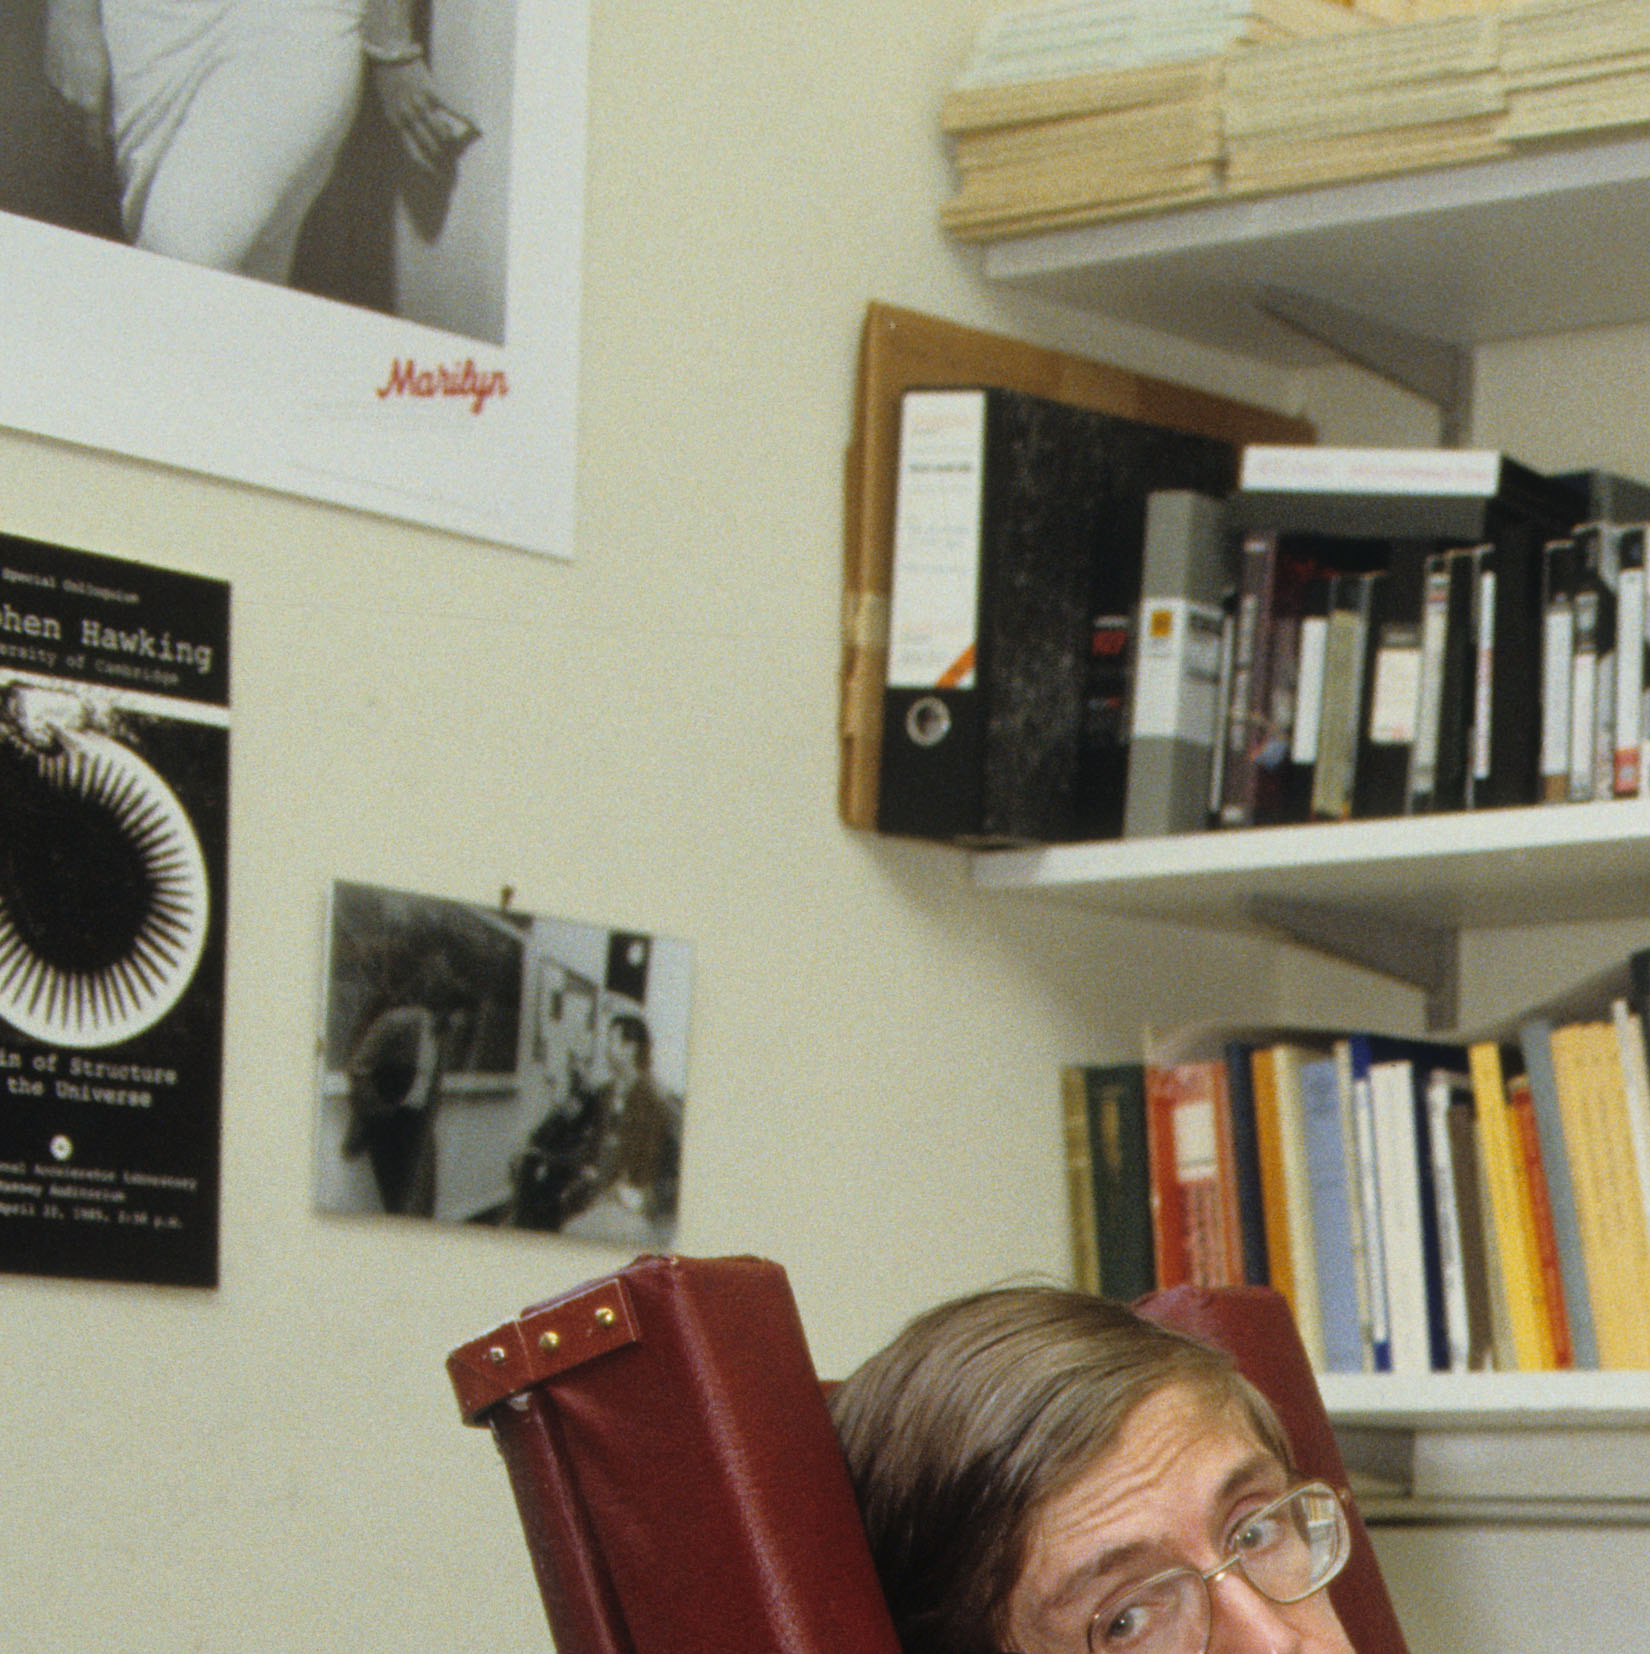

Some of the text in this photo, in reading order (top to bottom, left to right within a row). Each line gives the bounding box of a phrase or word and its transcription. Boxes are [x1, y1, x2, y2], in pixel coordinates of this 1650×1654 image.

[376, 357, 509, 415] Marilyn
[80, 617, 214, 675] Hawking
[6, 1075, 153, 1109] the Universe
[31, 1053, 60, 1073] of
[68, 1056, 179, 1087] Structure
